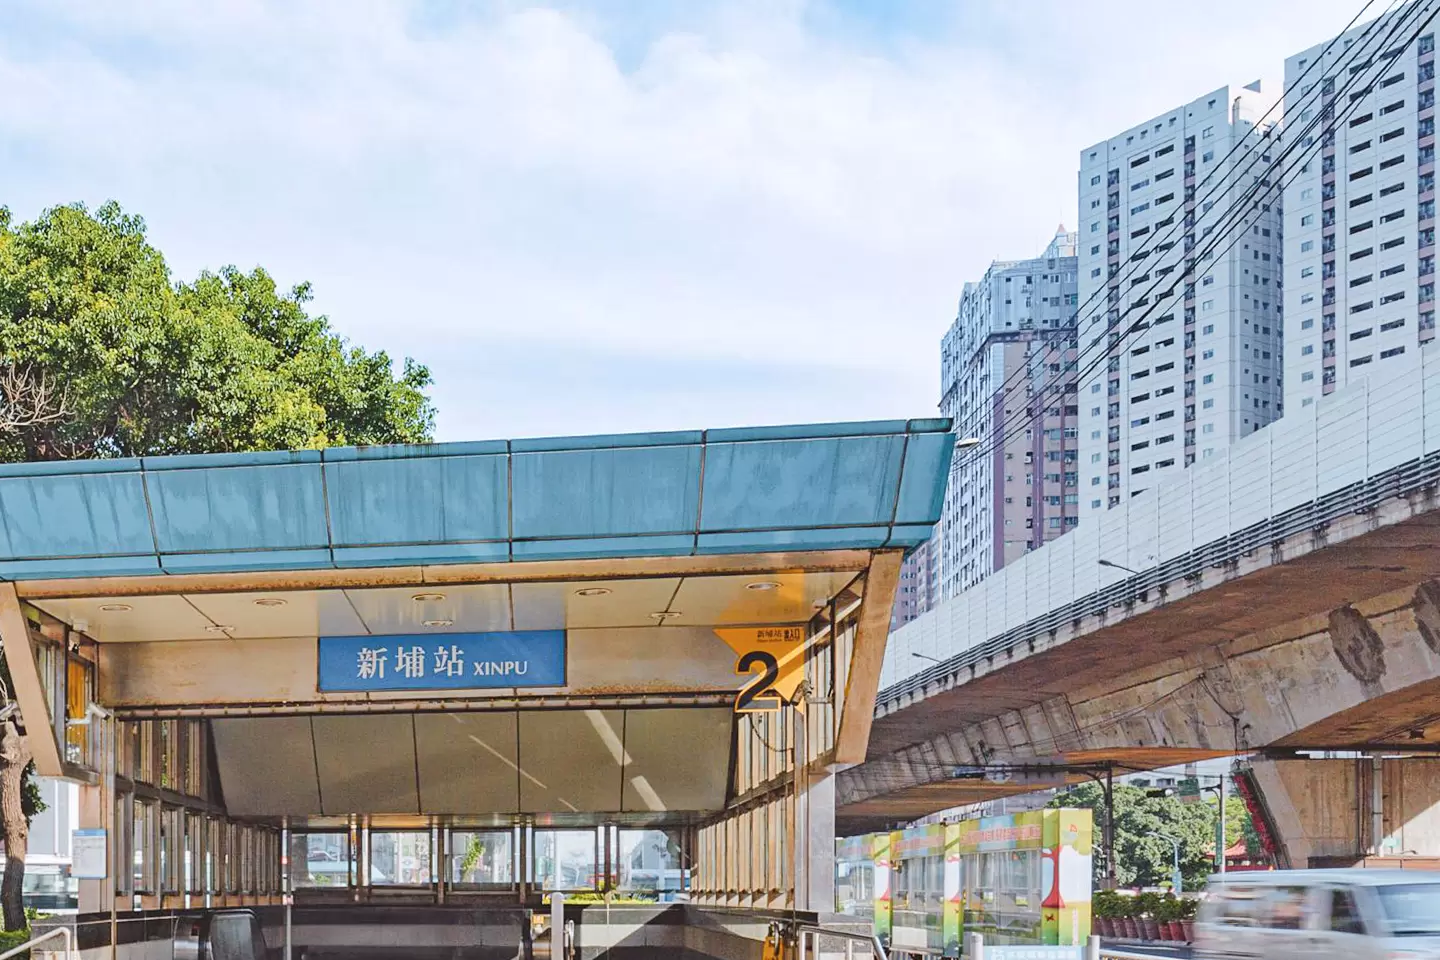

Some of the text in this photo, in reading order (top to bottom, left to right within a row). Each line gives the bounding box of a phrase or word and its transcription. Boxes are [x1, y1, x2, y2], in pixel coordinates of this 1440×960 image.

[356, 645, 527, 679] 新埔站 XINPU
[735, 650, 781, 712] 2
